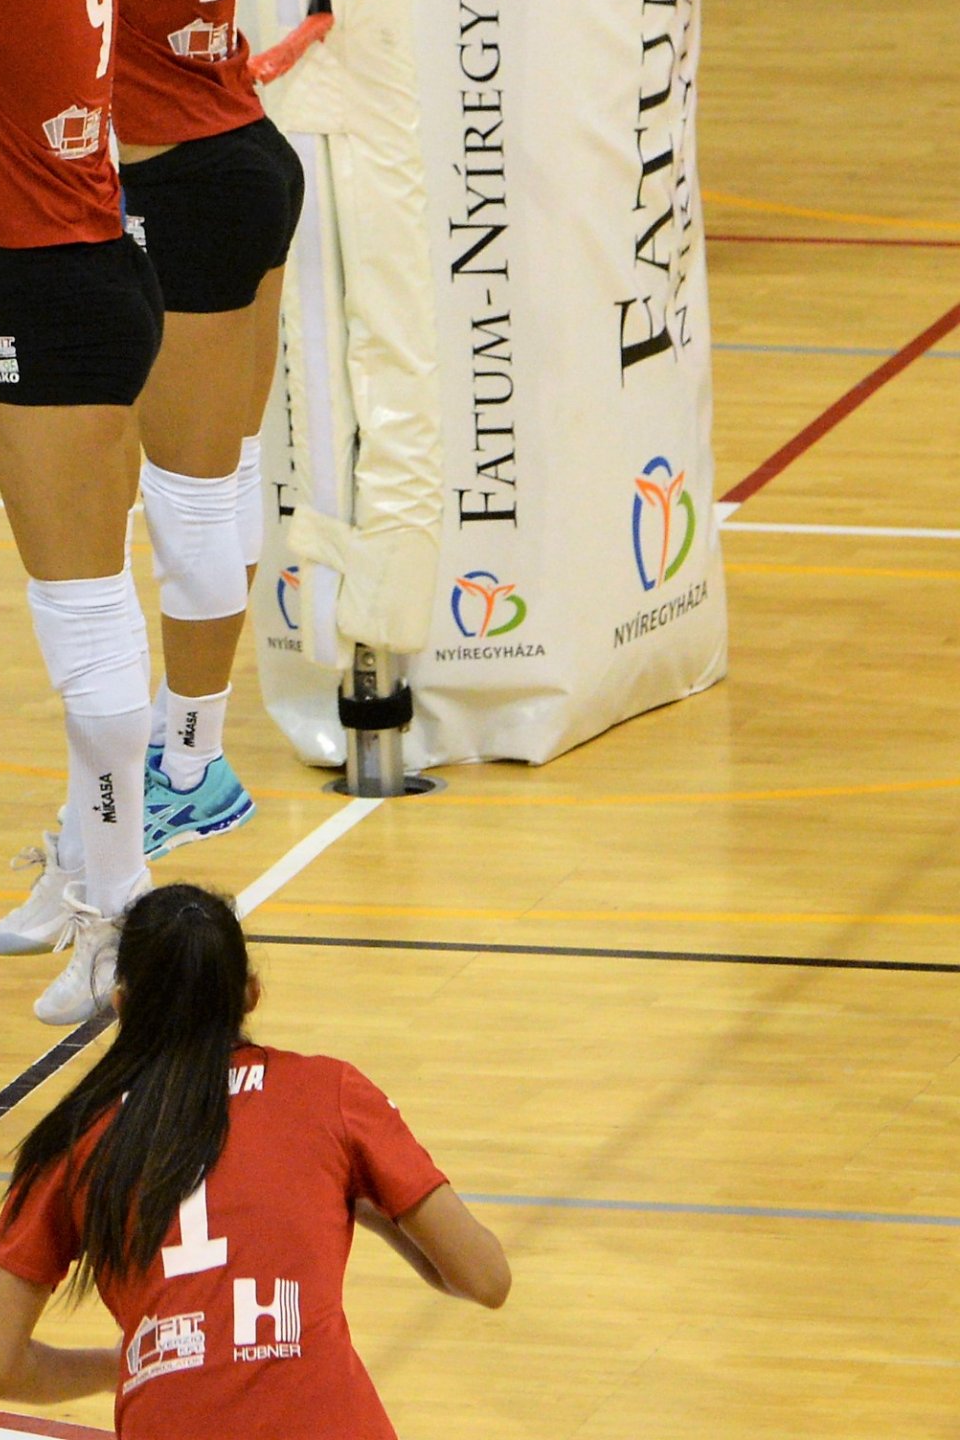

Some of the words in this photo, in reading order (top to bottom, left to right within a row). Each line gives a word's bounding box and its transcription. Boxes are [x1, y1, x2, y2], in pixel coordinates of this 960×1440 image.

[614, 580, 708, 648] NYÍREGYHÁZA
[435, 644, 546, 661] NYÍREGYHÁZA
[234, 1343, 302, 1362] HÜBNER
